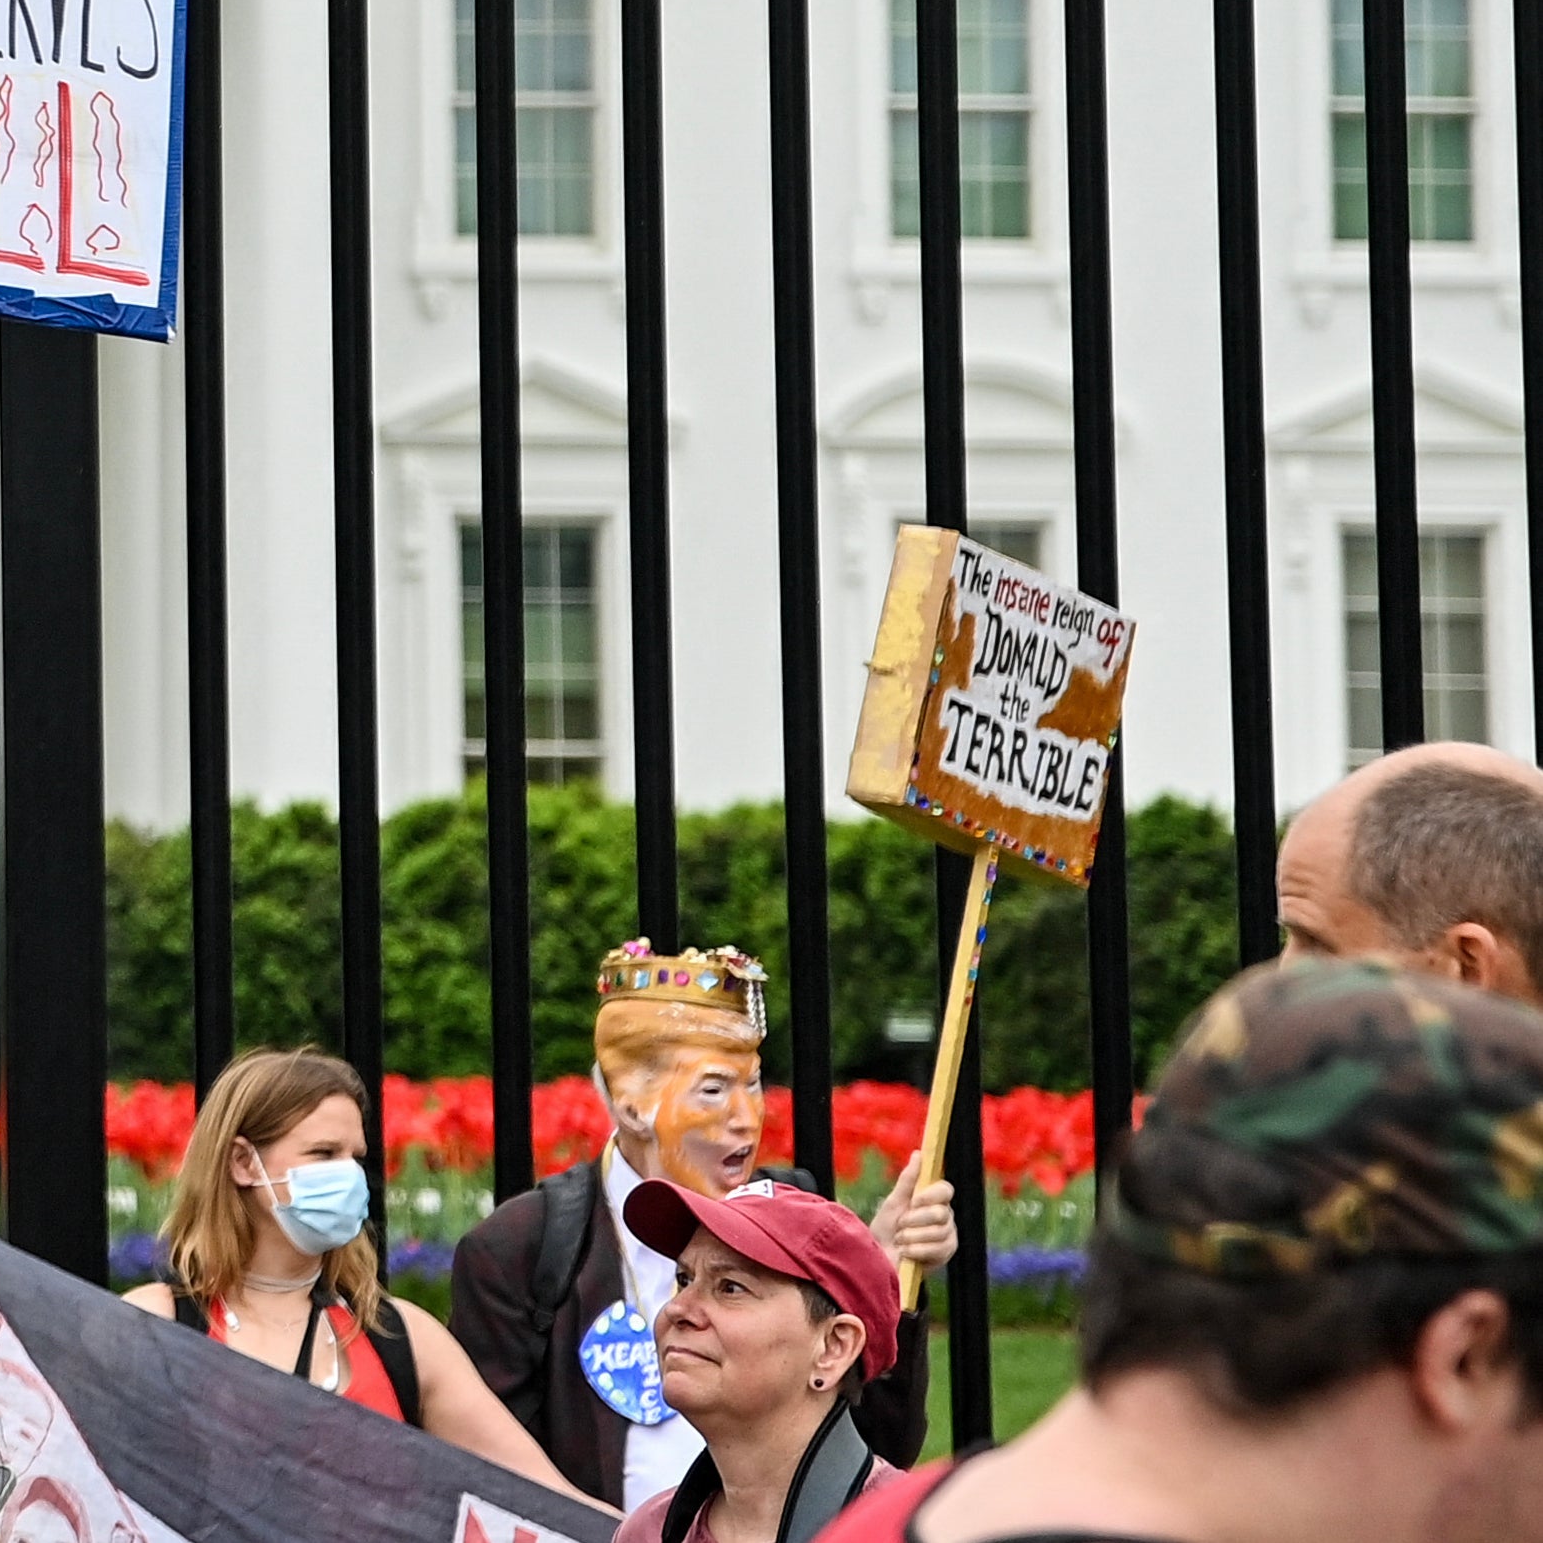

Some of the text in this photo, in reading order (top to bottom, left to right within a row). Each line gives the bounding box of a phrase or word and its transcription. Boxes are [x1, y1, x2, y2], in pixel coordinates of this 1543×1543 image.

[960, 550, 1125, 668] The insane reign of
[973, 606, 1067, 701] DONALD
[1000, 681, 1030, 721] the
[946, 698, 1100, 811] TERRIBLE
